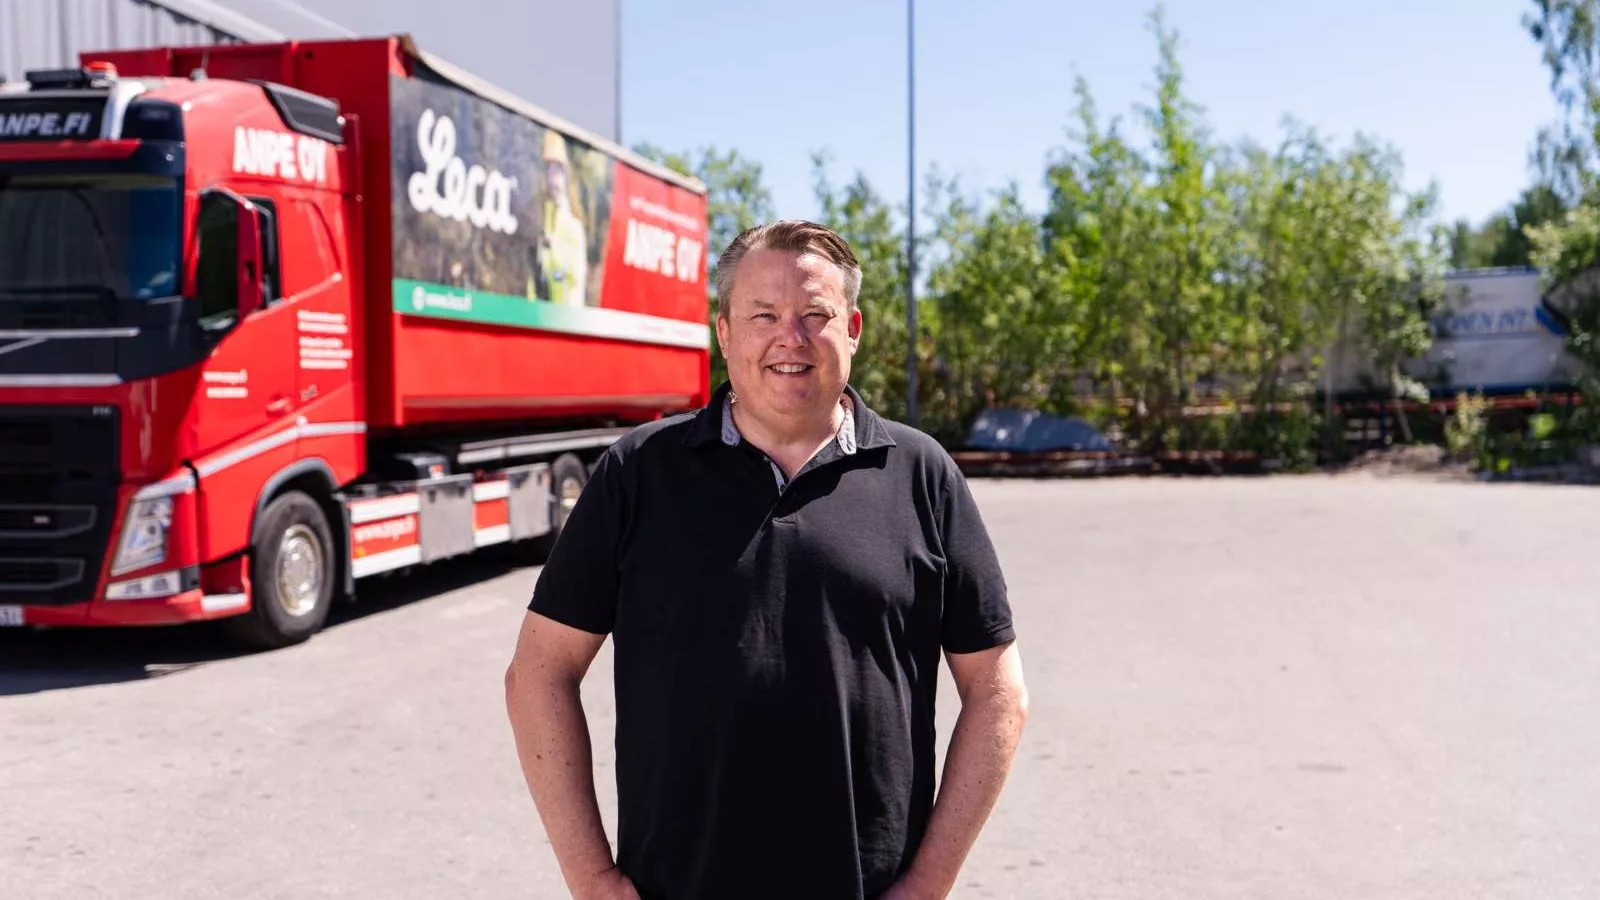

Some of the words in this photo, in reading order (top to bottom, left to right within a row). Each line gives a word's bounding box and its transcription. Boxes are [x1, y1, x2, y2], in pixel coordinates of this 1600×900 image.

[233, 126, 295, 179] ANPE
[296, 136, 327, 182] OY
[408, 108, 518, 235] Leca
[624, 219, 676, 278] ANPE
[676, 237, 702, 284] OY
